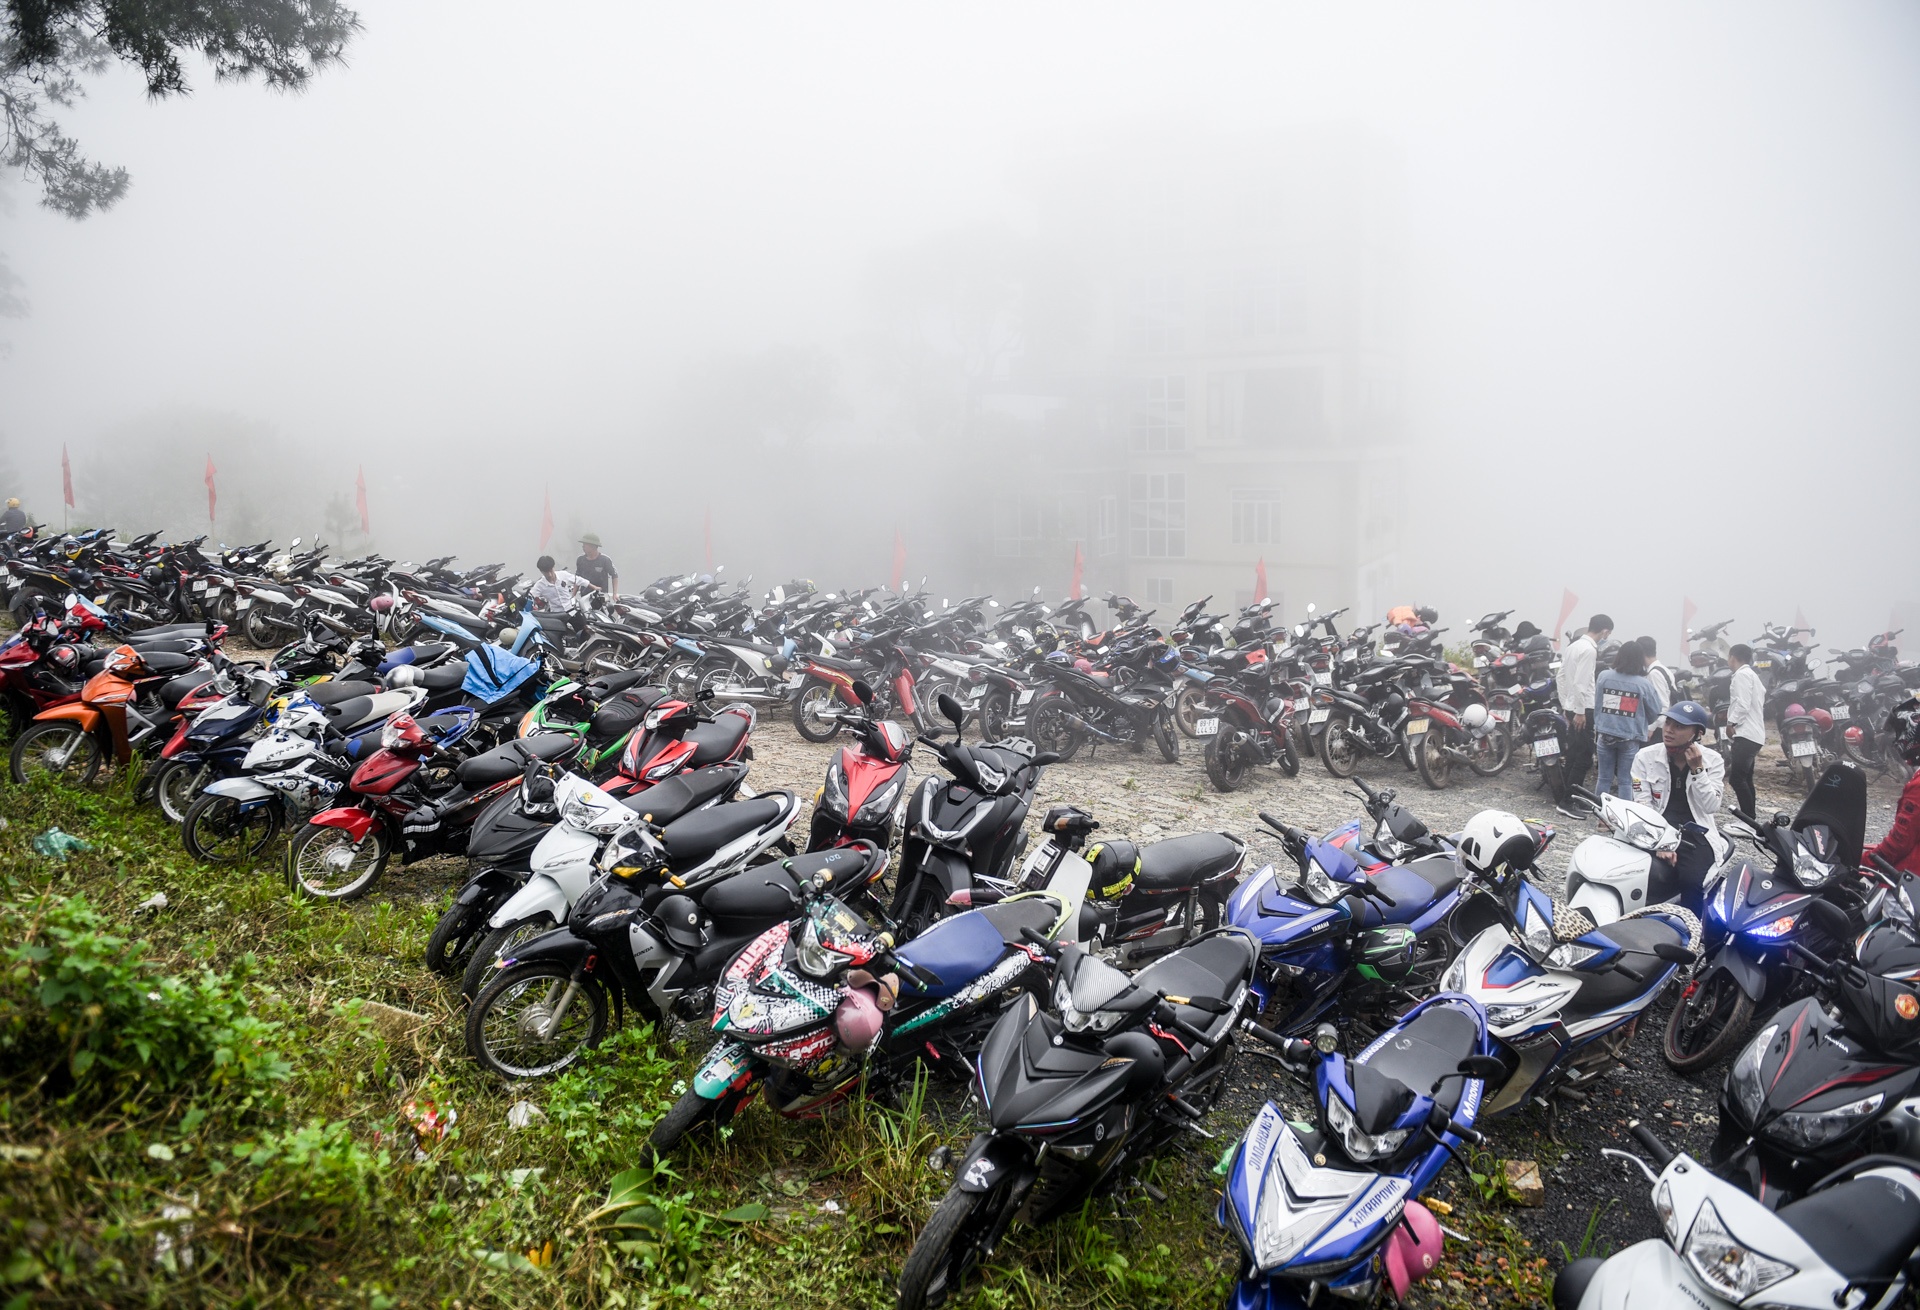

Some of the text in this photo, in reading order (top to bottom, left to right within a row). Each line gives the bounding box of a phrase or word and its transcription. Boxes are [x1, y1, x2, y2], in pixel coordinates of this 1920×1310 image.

[1605, 689, 1638, 698] TOMMY
[1602, 708, 1635, 717] JEANS
[1310, 920, 1330, 933] YAMAHA
[789, 1034, 836, 1061] RAPTO
